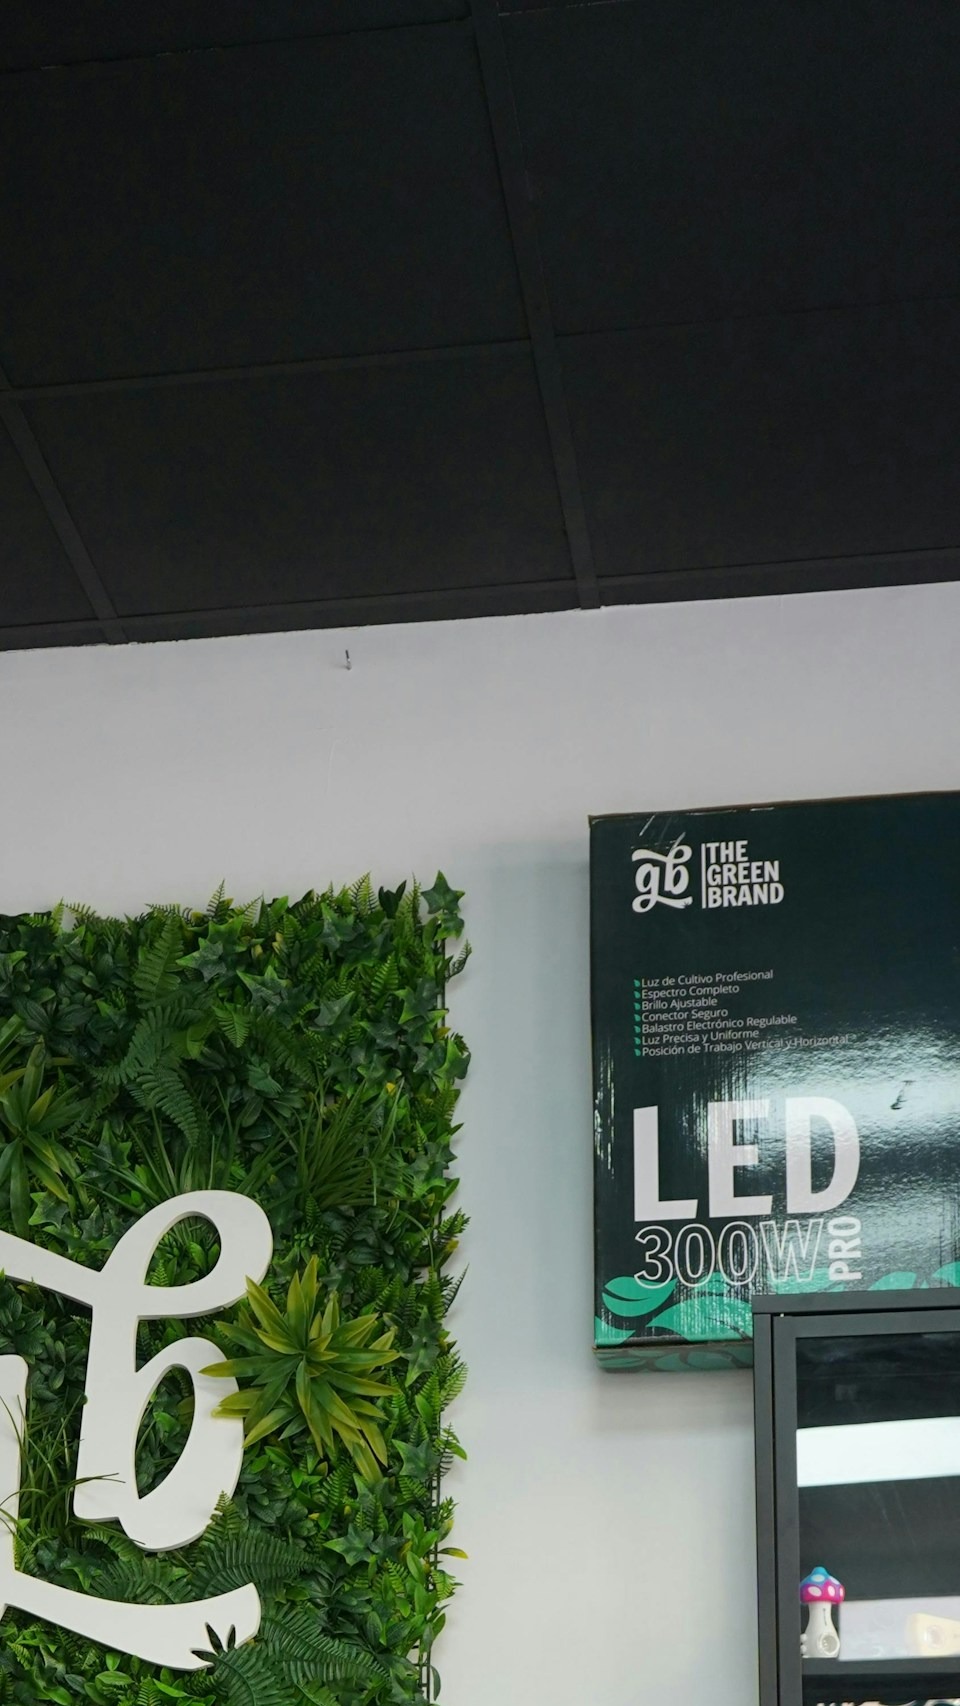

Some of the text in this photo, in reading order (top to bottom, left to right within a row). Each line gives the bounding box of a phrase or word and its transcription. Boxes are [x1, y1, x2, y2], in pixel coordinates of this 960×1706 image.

[706, 840, 748, 863] THE
[632, 845, 693, 913] gb
[707, 861, 780, 886] GREEN
[708, 883, 785, 909] BRAND
[641, 969, 774, 988] Luz de Cultivo Profesional
[641, 984, 740, 1000] Espectro Completo
[641, 997, 718, 1010] Brillo Ajustable
[641, 1009, 728, 1022] Conector Seguro
[642, 1014, 797, 1034] Balastro Electrónico Regulable
[642, 1029, 760, 1045] Luz Precisa y Uniforme
[642, 1045, 685, 1056] Posición
[687, 1044, 701, 1054] de
[703, 1042, 742, 1053] Trabajo
[744, 1038, 783, 1050] Vertical
[794, 1034, 849, 1047] Horizontal
[633, 1097, 860, 1222] LED
[634, 1216, 862, 1289] 300W PRO
